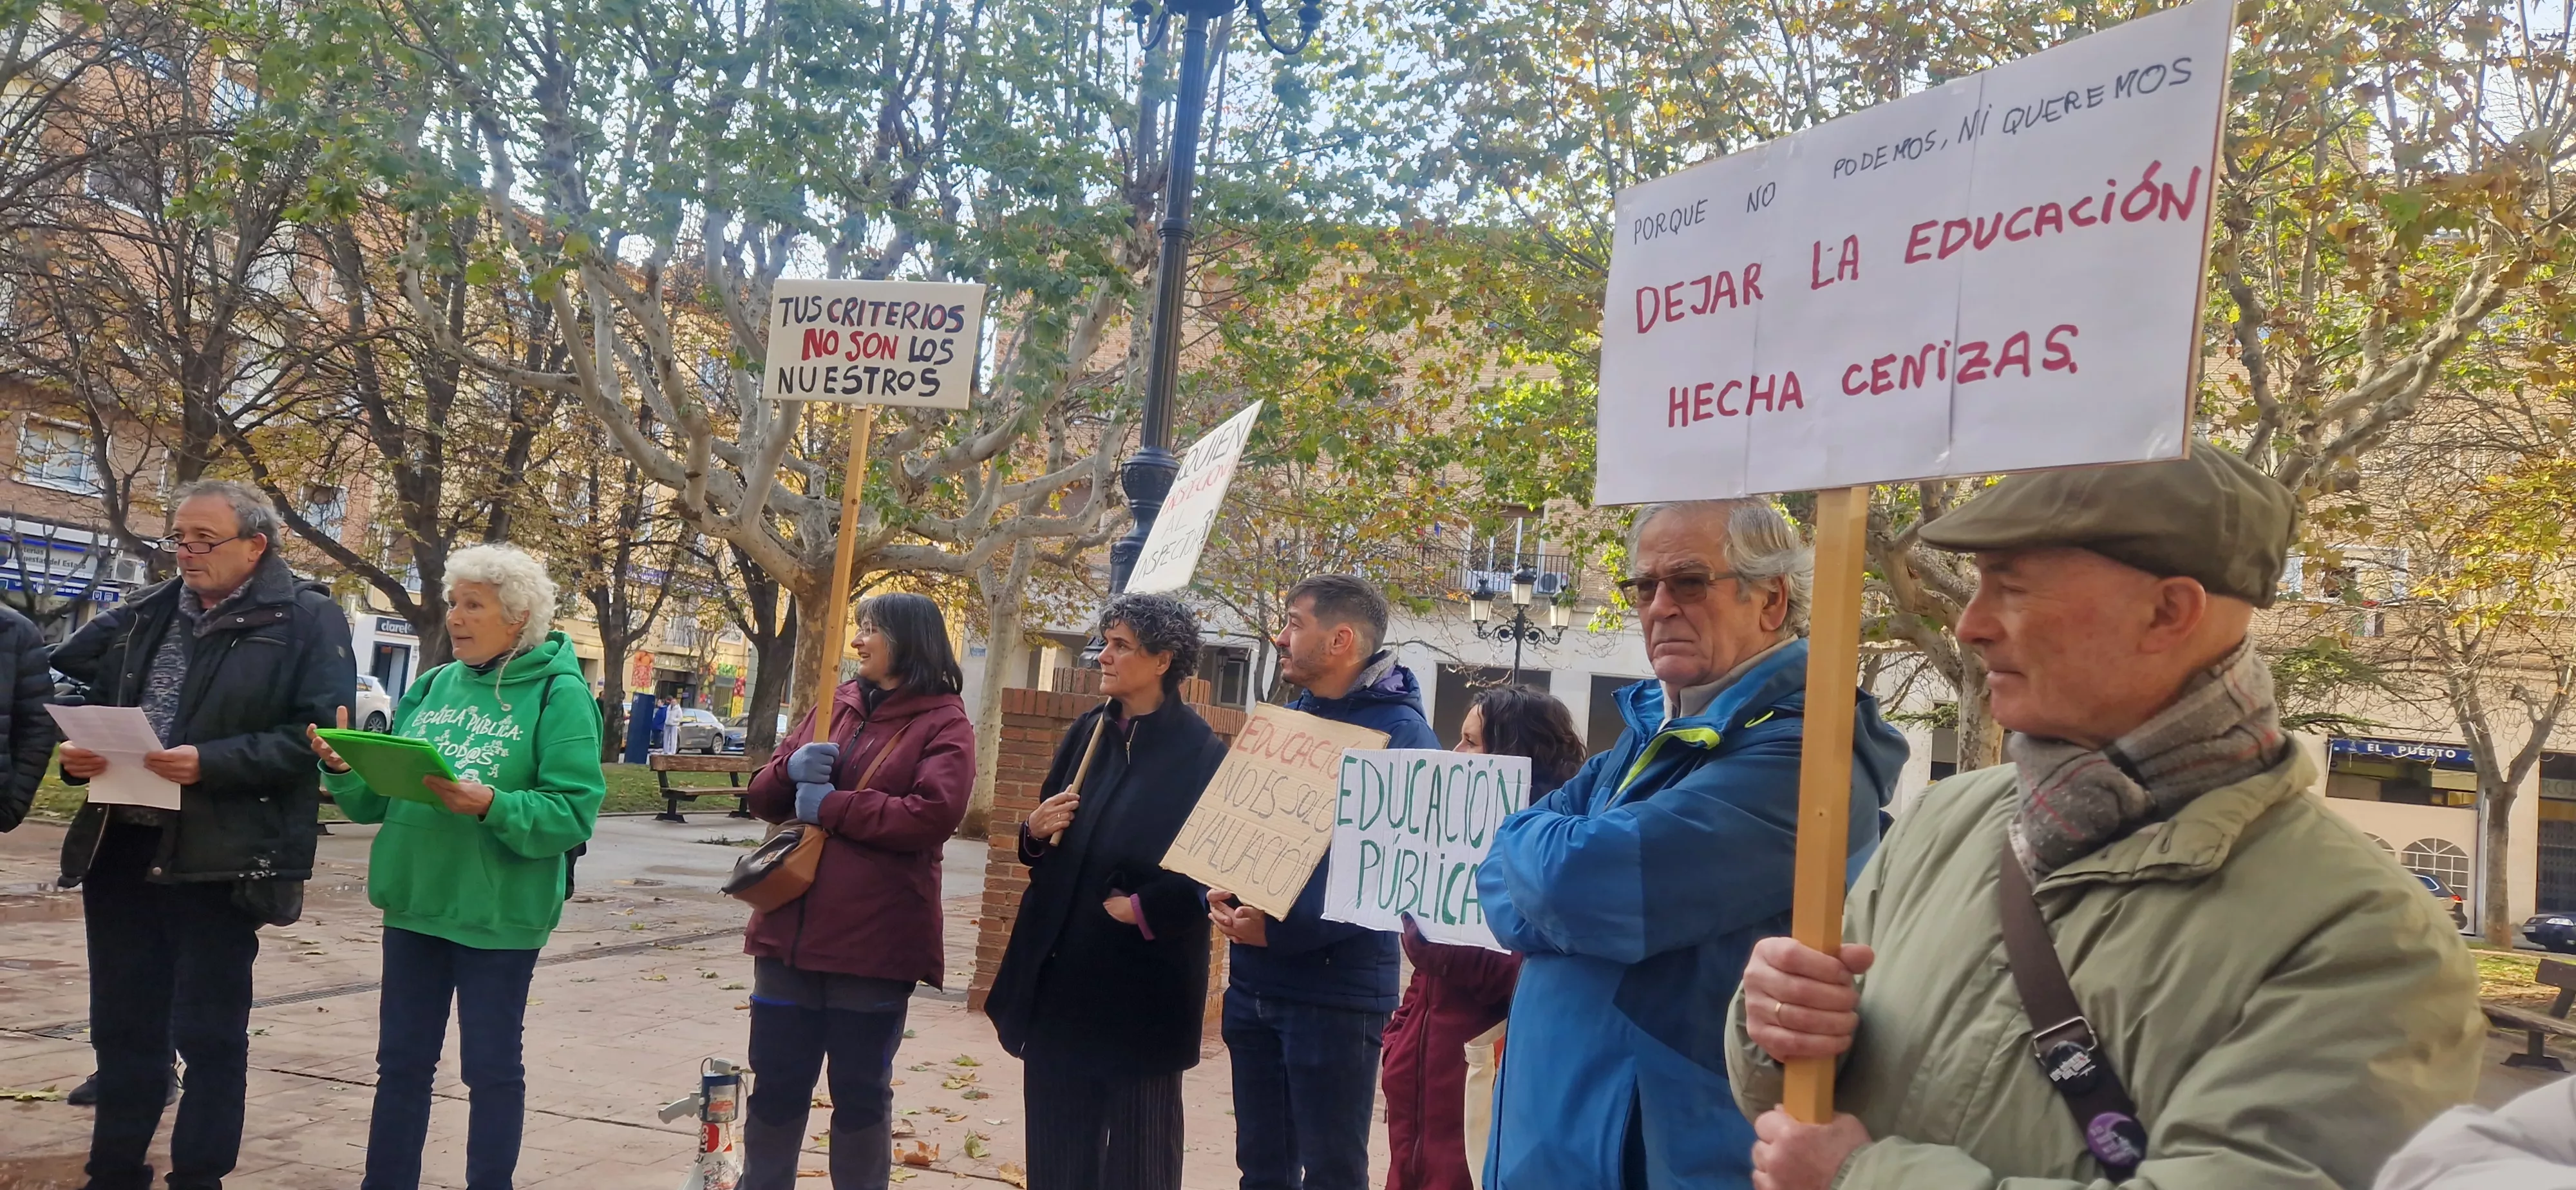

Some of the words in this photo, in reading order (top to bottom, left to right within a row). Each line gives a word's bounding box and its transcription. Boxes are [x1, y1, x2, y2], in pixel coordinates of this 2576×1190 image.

[1634, 199, 1709, 245] PORQUE
[1746, 182, 1776, 213] NO
[1833, 129, 1947, 179] PODEMOS,
[2002, 57, 2192, 135] QUEREMOS
[1634, 263, 1764, 334] DEJAR
[1810, 234, 1860, 290] LA
[778, 295, 822, 328] TUS
[826, 296, 965, 334] CRITERIOS
[801, 328, 839, 361] NO
[845, 330, 899, 362] SON
[907, 335, 954, 366] LOS
[777, 364, 941, 397] NUESTROS
[1667, 370, 1804, 428] HECHA
[1161, 509, 1188, 540] AL
[381, 620, 408, 634] clarel
[465, 713, 524, 741] PÚBLICA:
[437, 742, 495, 765] TOD@S
[1236, 715, 1361, 780] EDUCACIÓ
[2367, 743, 2383, 753] EL
[2398, 745, 2456, 759] PUERTO
[1213, 760, 1258, 808] NO
[1248, 769, 1289, 819] ES
[1279, 783, 1336, 833] SOLO
[1175, 806, 1320, 902] EVALUACIÓN
